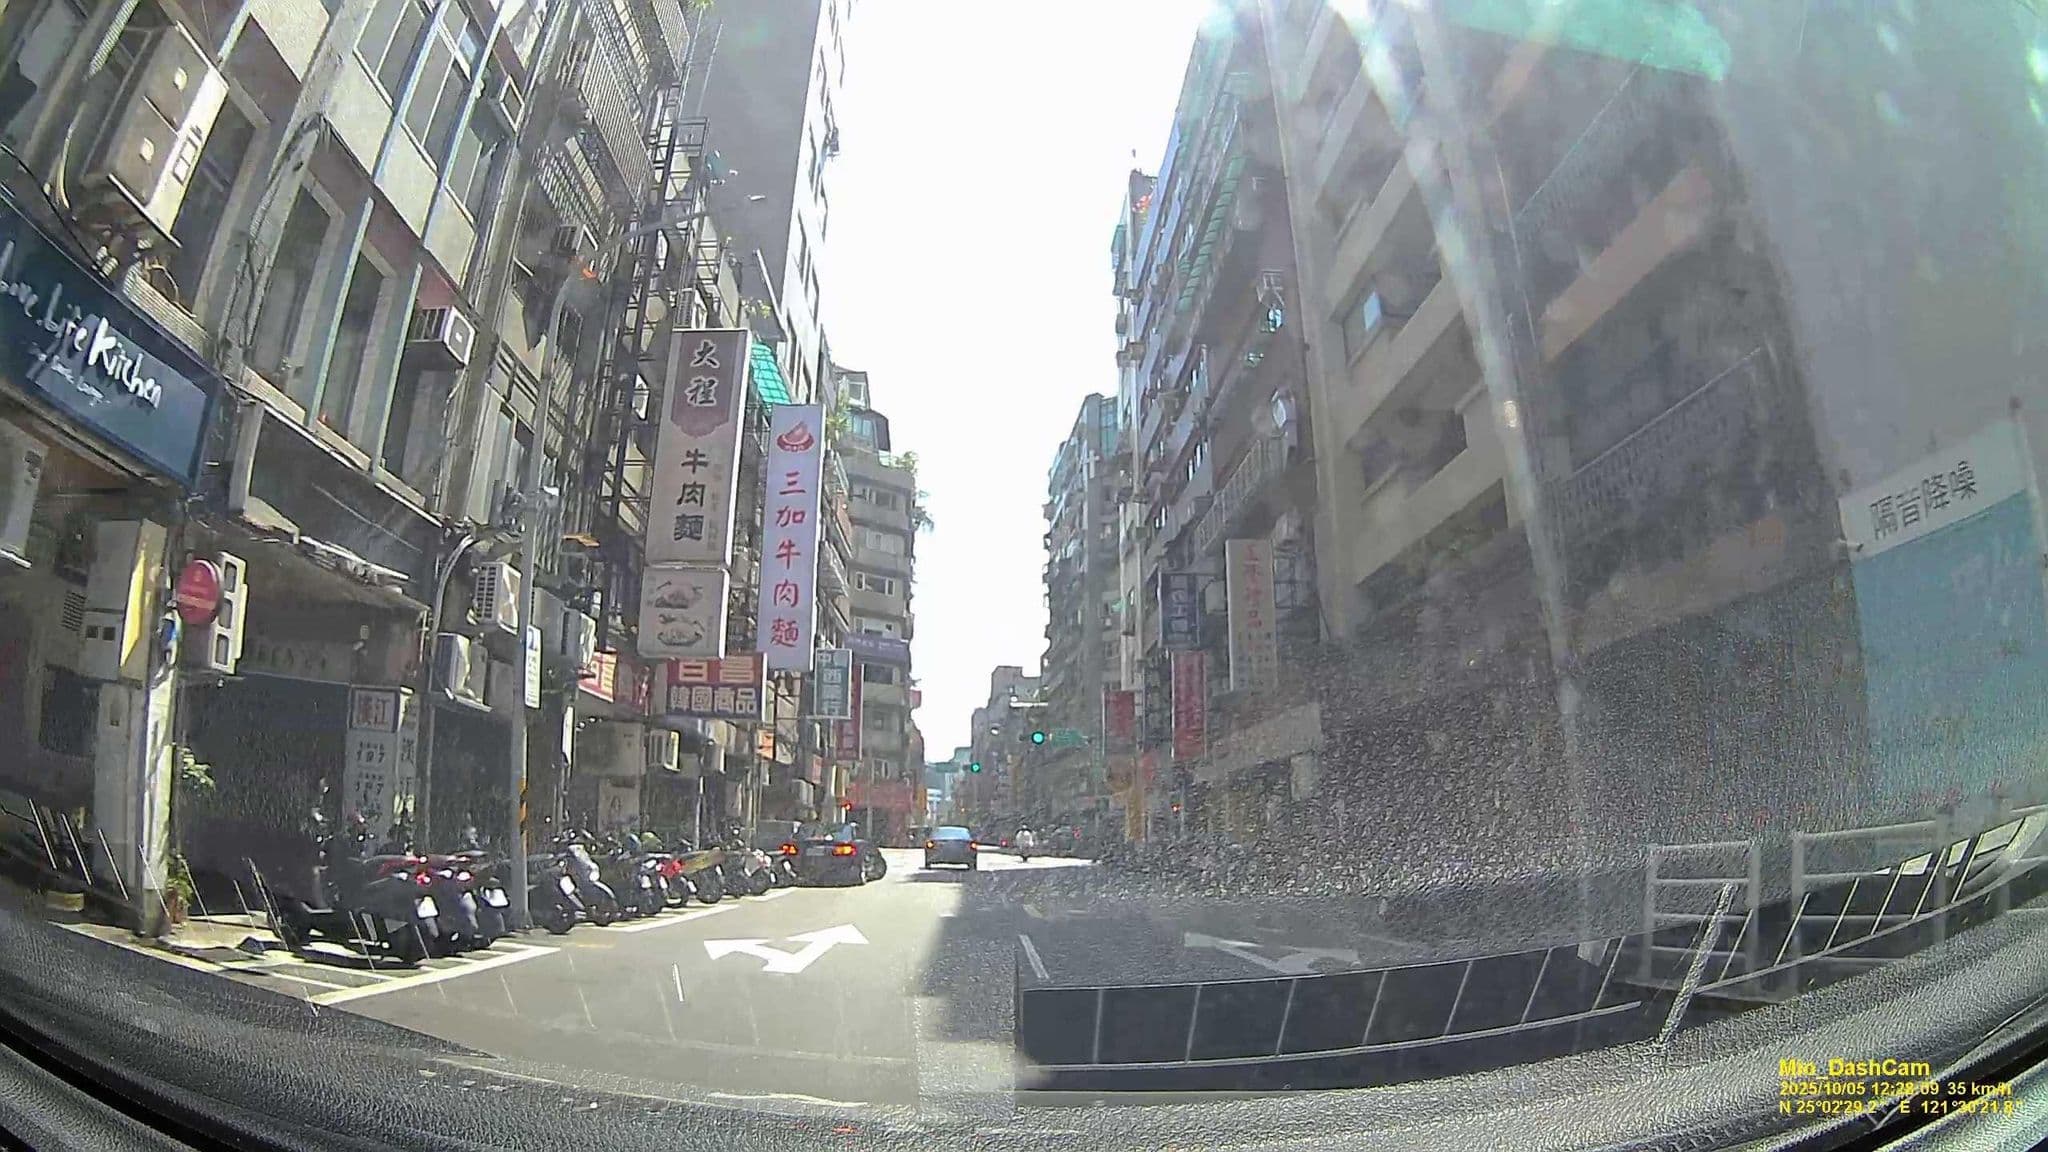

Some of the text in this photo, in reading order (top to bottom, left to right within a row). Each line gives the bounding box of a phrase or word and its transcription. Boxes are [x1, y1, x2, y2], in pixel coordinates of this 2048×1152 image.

[88, 317, 162, 409] Kitchen
[674, 448, 710, 541] 牛肉麵
[1869, 460, 1978, 540] 隔音降噪
[770, 470, 806, 648] 三加牛肉麵
[670, 685, 757, 714] 韓國商品
